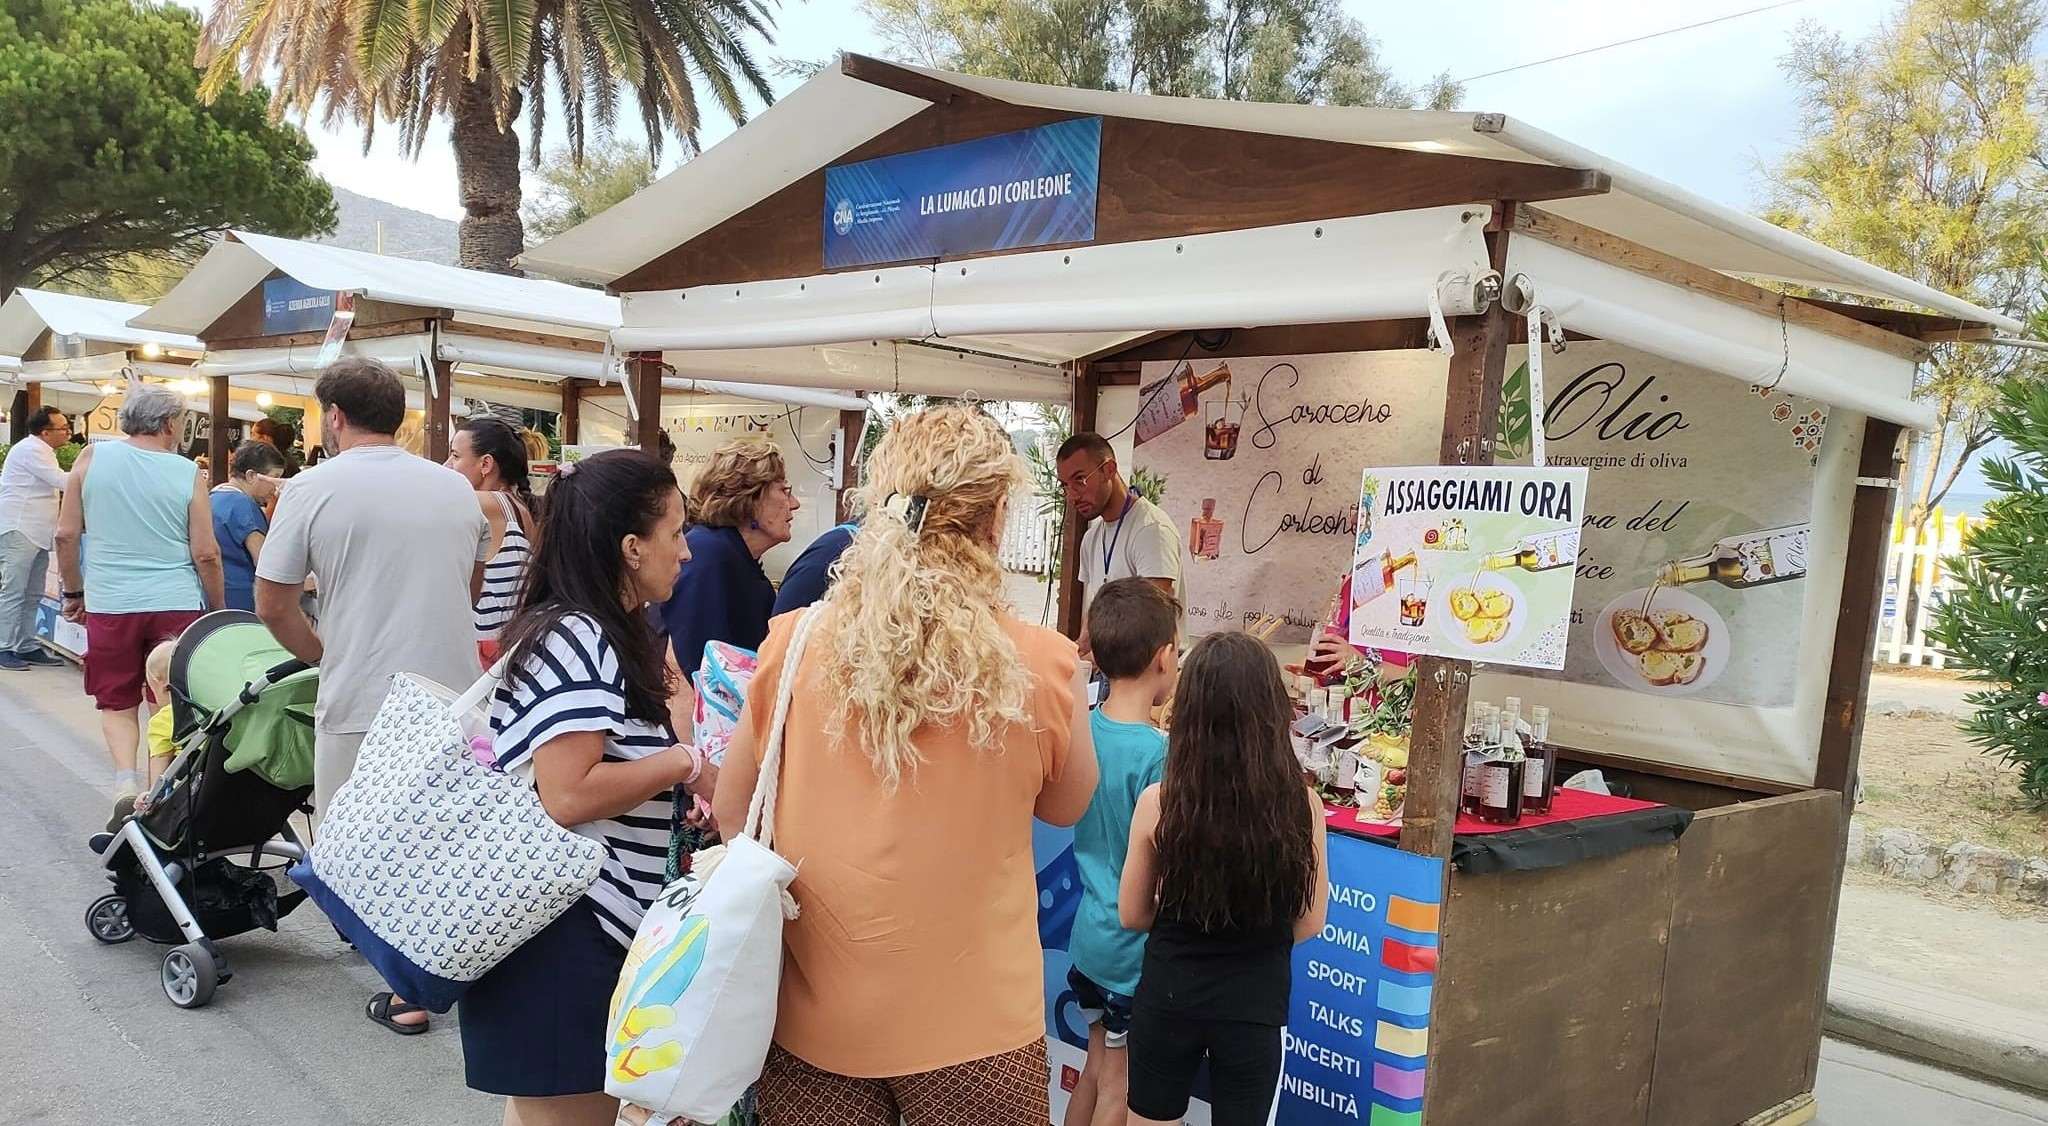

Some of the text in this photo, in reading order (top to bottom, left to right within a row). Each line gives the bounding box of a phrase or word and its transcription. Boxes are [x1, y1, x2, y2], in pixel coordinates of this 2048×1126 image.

[920, 194, 935, 215] LA
[937, 187, 985, 213] LUMACA
[988, 184, 1002, 206] DI
[1005, 172, 1072, 203] CORLEONE
[833, 207, 853, 225] CNA
[1252, 363, 1392, 449] Saraceno
[1541, 362, 1691, 441] Olio
[1303, 452, 1324, 485] di
[1545, 453, 1688, 471] xtravergine di oliva
[1384, 479, 1572, 522] ASSAGGIAMI ORA
[1626, 499, 1690, 532] del
[1575, 547, 1615, 580] lice
[1328, 882, 1376, 912] NATO
[1317, 924, 1370, 955] OMIA
[1307, 960, 1367, 996] SPORT
[1308, 1001, 1363, 1037] TALKS
[1284, 1032, 1360, 1078] ONCERTI
[1280, 1074, 1359, 1119] NIBILITÀ
